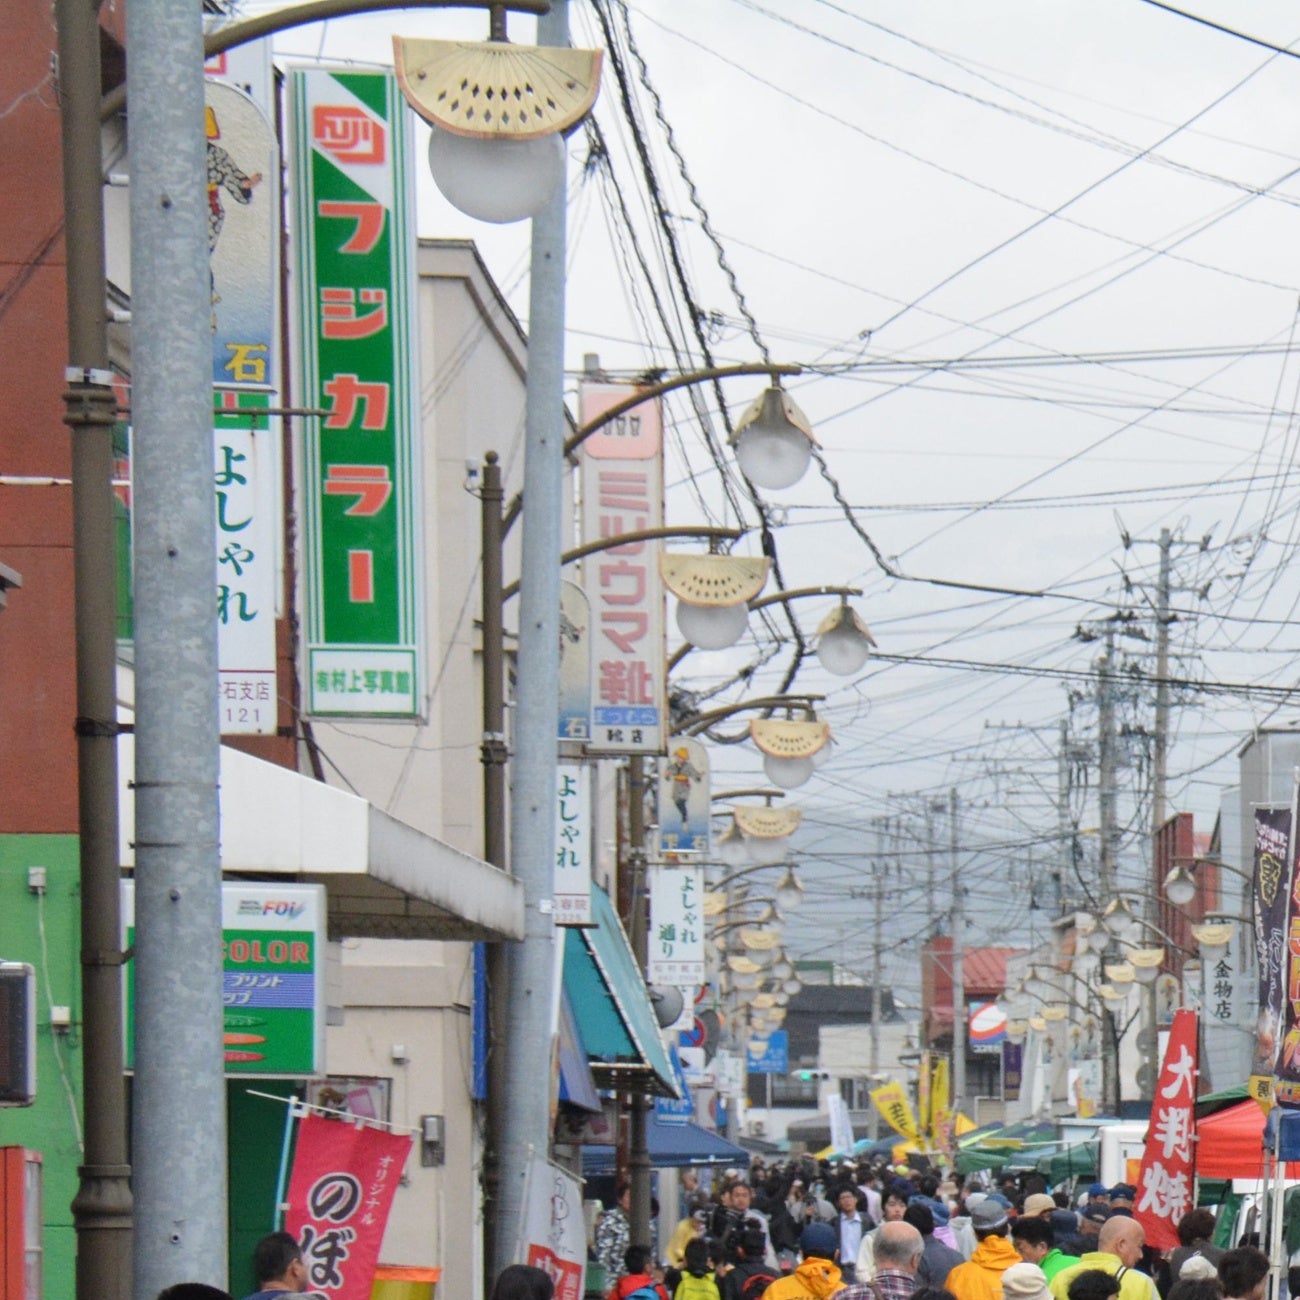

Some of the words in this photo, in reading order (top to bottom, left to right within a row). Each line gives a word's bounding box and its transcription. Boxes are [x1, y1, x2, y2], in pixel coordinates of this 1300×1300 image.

[318, 200, 394, 604] フジカラー
[219, 681, 270, 701] 石支店
[557, 775, 580, 868] よしゃれ
[221, 939, 310, 965] OLOR
[1137, 1043, 1195, 1227] 大判焼
[298, 1171, 363, 1300] のぼ
